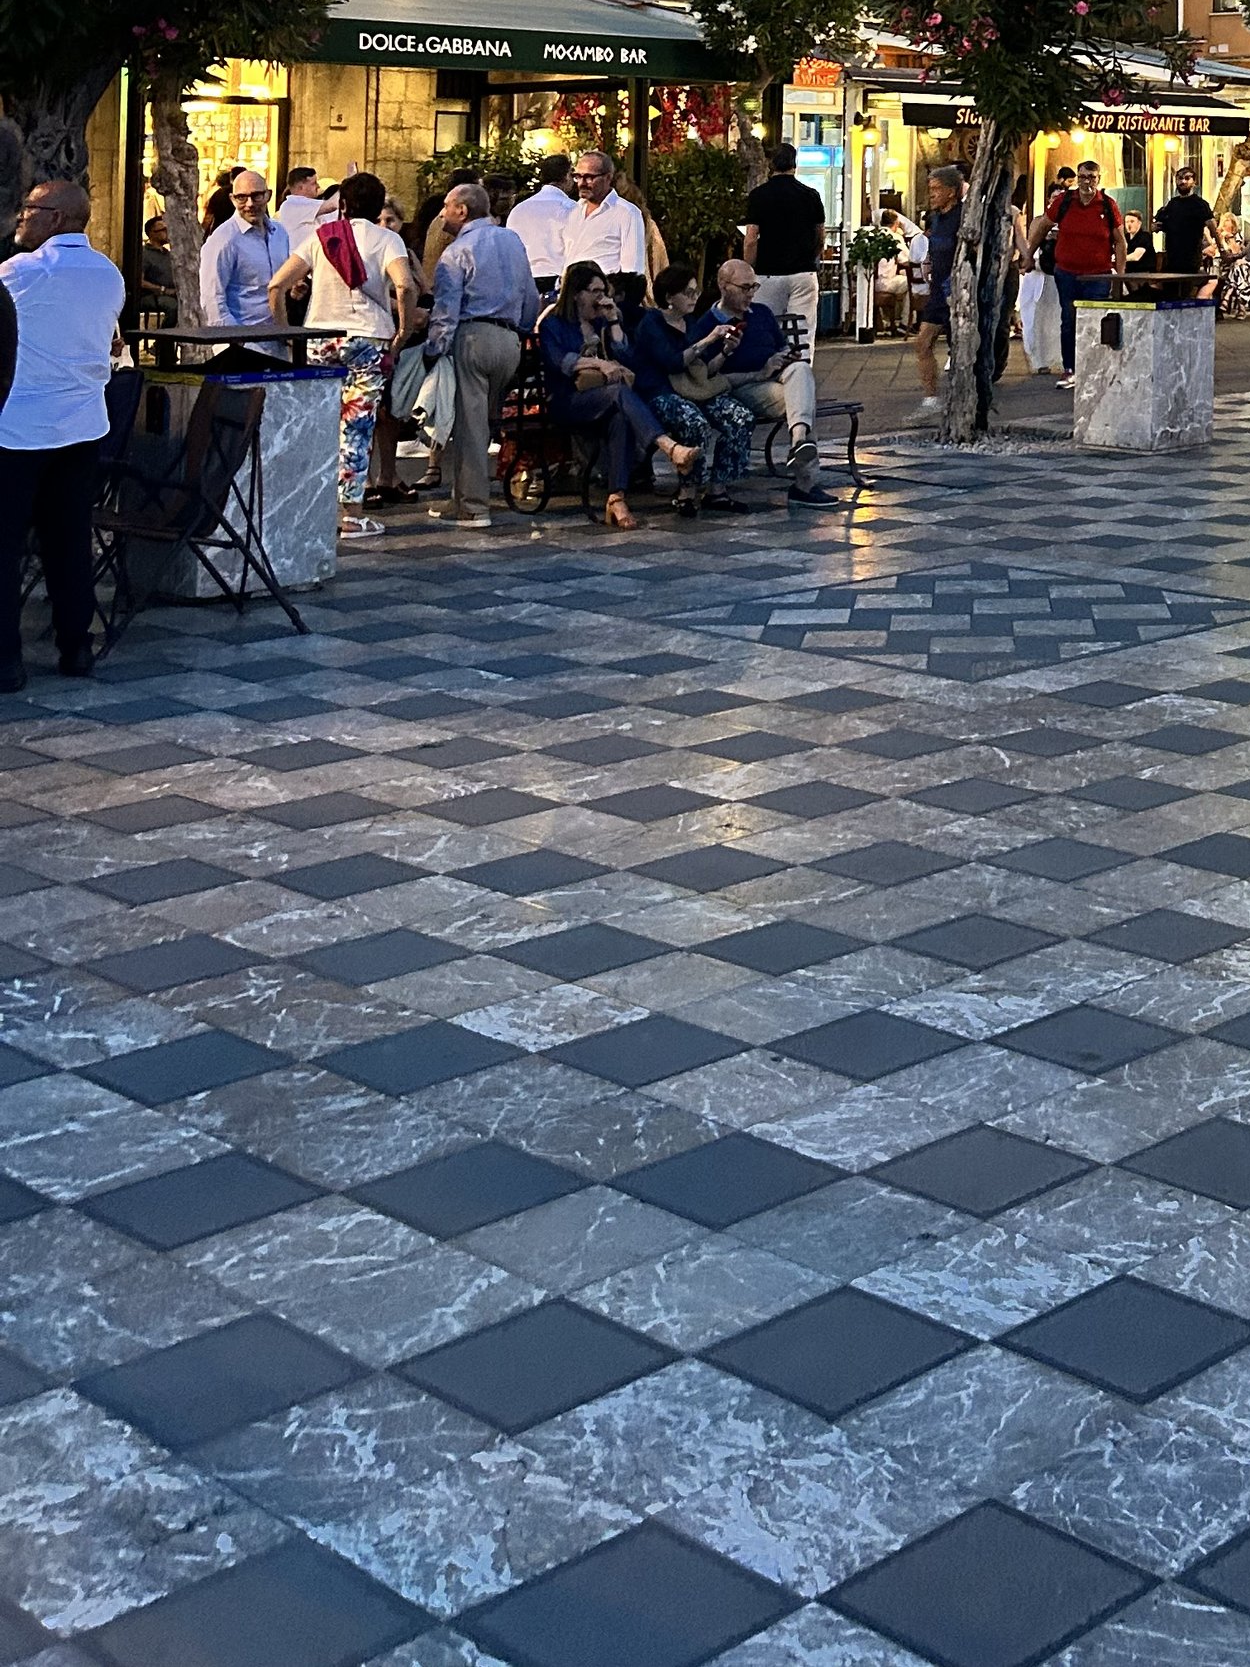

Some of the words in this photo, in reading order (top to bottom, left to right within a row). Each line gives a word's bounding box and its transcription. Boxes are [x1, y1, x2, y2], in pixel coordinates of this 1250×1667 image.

[358, 32, 512, 58] DOLCE&GABBANA
[543, 43, 614, 63] MOCAMBO
[620, 47, 648, 65] BAR
[1084, 114, 1114, 130] STOP
[1117, 115, 1185, 132] RISTORANTE
[1189, 117, 1210, 133] BAR
